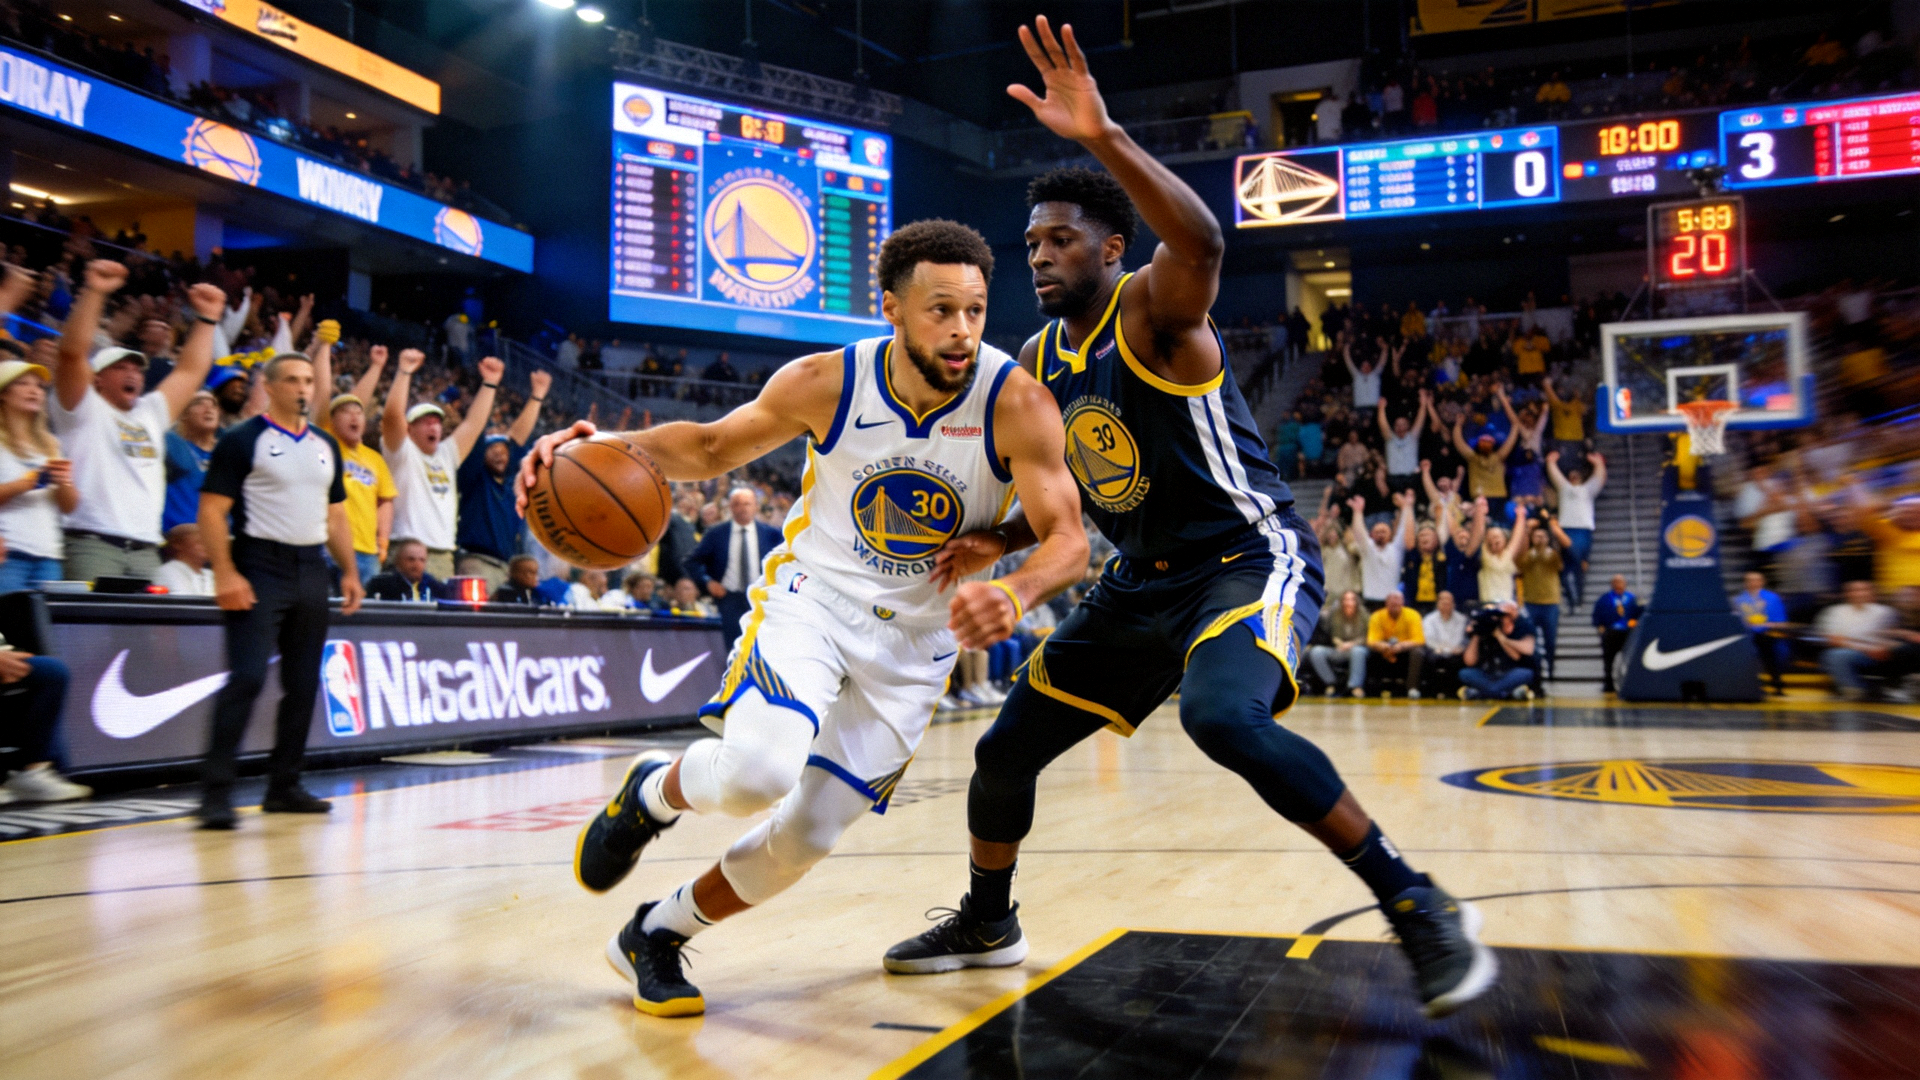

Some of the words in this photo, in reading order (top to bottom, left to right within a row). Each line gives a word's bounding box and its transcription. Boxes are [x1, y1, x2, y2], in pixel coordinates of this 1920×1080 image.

[1514, 151, 1546, 197] 0
[1738, 131, 1776, 179] 3
[1672, 234, 1726, 275] 20
[1091, 422, 1116, 453] 39
[911, 489, 950, 520] 30
